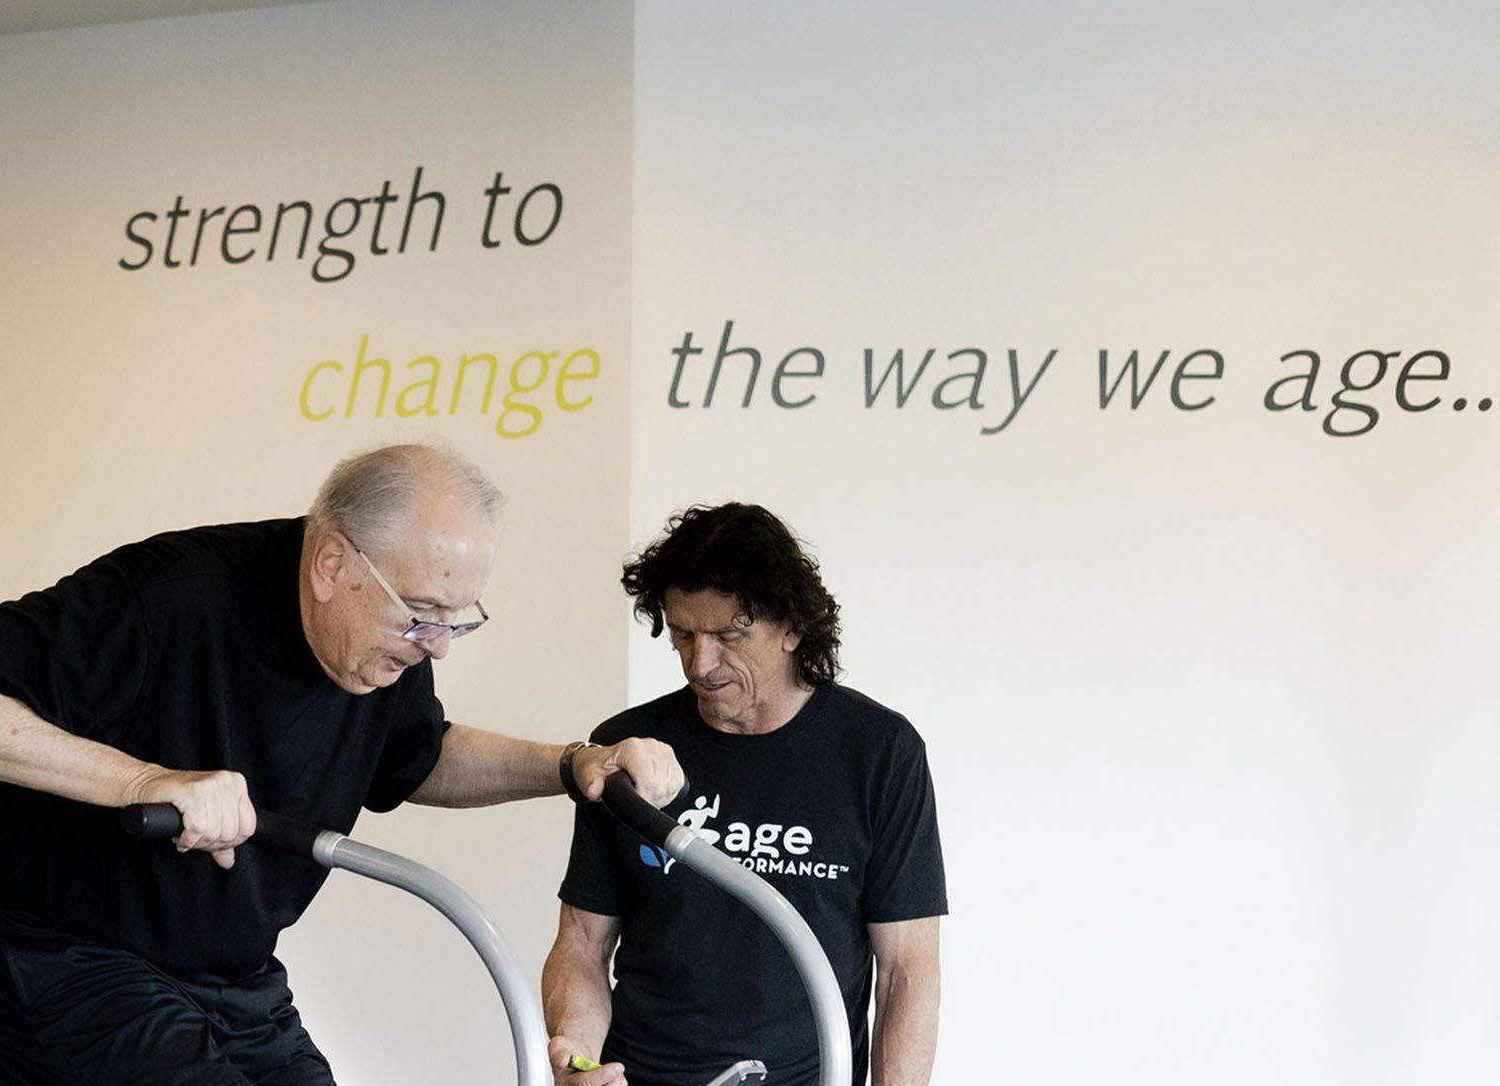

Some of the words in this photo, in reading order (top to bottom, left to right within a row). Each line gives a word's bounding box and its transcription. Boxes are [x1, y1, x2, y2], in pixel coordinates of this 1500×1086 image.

[119, 166, 449, 286] strength
[482, 171, 566, 250] to
[299, 335, 603, 441] change
[668, 321, 828, 413] the
[863, 347, 1061, 438] way
[1099, 349, 1227, 414] we
[723, 821, 814, 859] age
